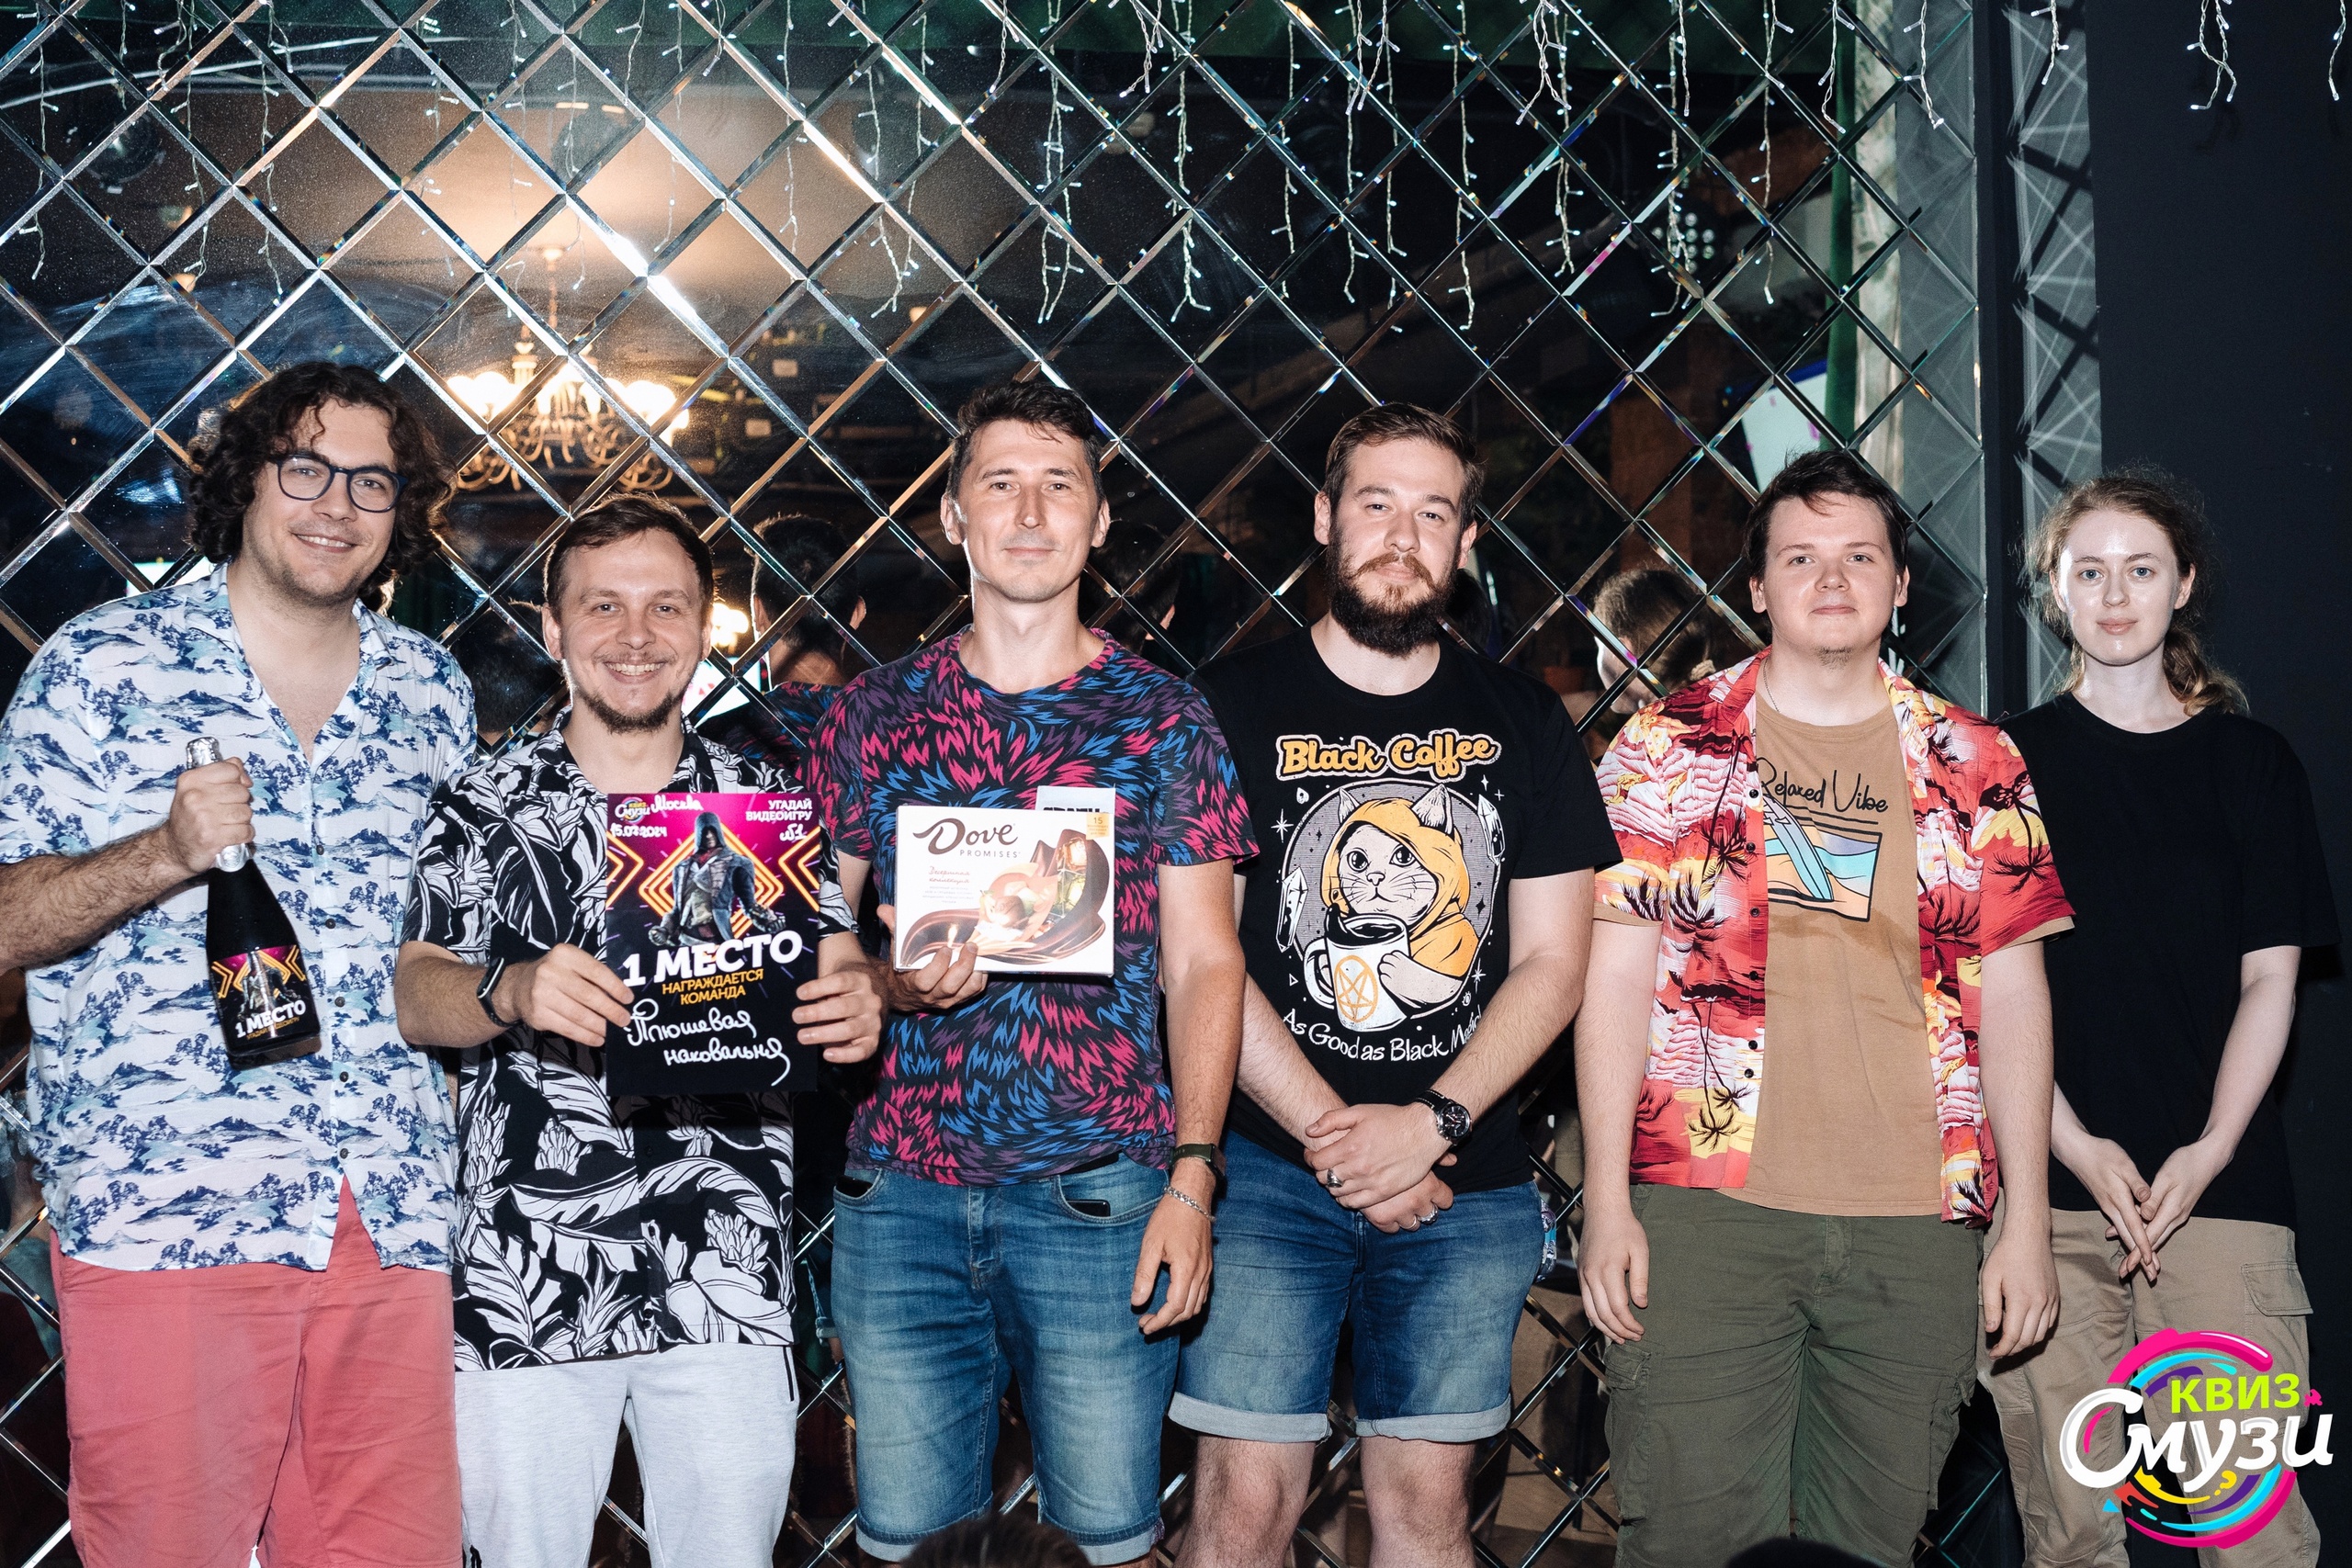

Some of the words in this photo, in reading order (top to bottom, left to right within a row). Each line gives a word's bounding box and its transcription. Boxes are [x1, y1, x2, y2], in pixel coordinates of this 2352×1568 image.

[1280, 739, 1385, 776] Black
[1389, 733, 1497, 779] Coffee
[767, 797, 813, 811] УГАДАЙ
[1756, 756, 1826, 808] Relaxed
[1833, 770, 1889, 813] Vibe
[745, 810, 813, 822] ВИДЕОИГРУ
[912, 818, 1018, 855] Dove
[959, 849, 1019, 859] PROMISES
[622, 953, 646, 987] 1
[653, 930, 803, 984] МЕСТО
[662, 968, 764, 995] НАГРАЖДАЕТСЯ
[680, 986, 747, 1006] КОМАНДА
[235, 1021, 246, 1038] 1
[246, 999, 307, 1033] МЕСТО
[623, 998, 757, 1046] Плюшевая
[1283, 1008, 1307, 1035] As
[1307, 1022, 1361, 1059] Good
[1361, 1044, 1385, 1061] as
[1389, 1034, 1450, 1062] Black
[663, 1037, 791, 1087] наковальня
